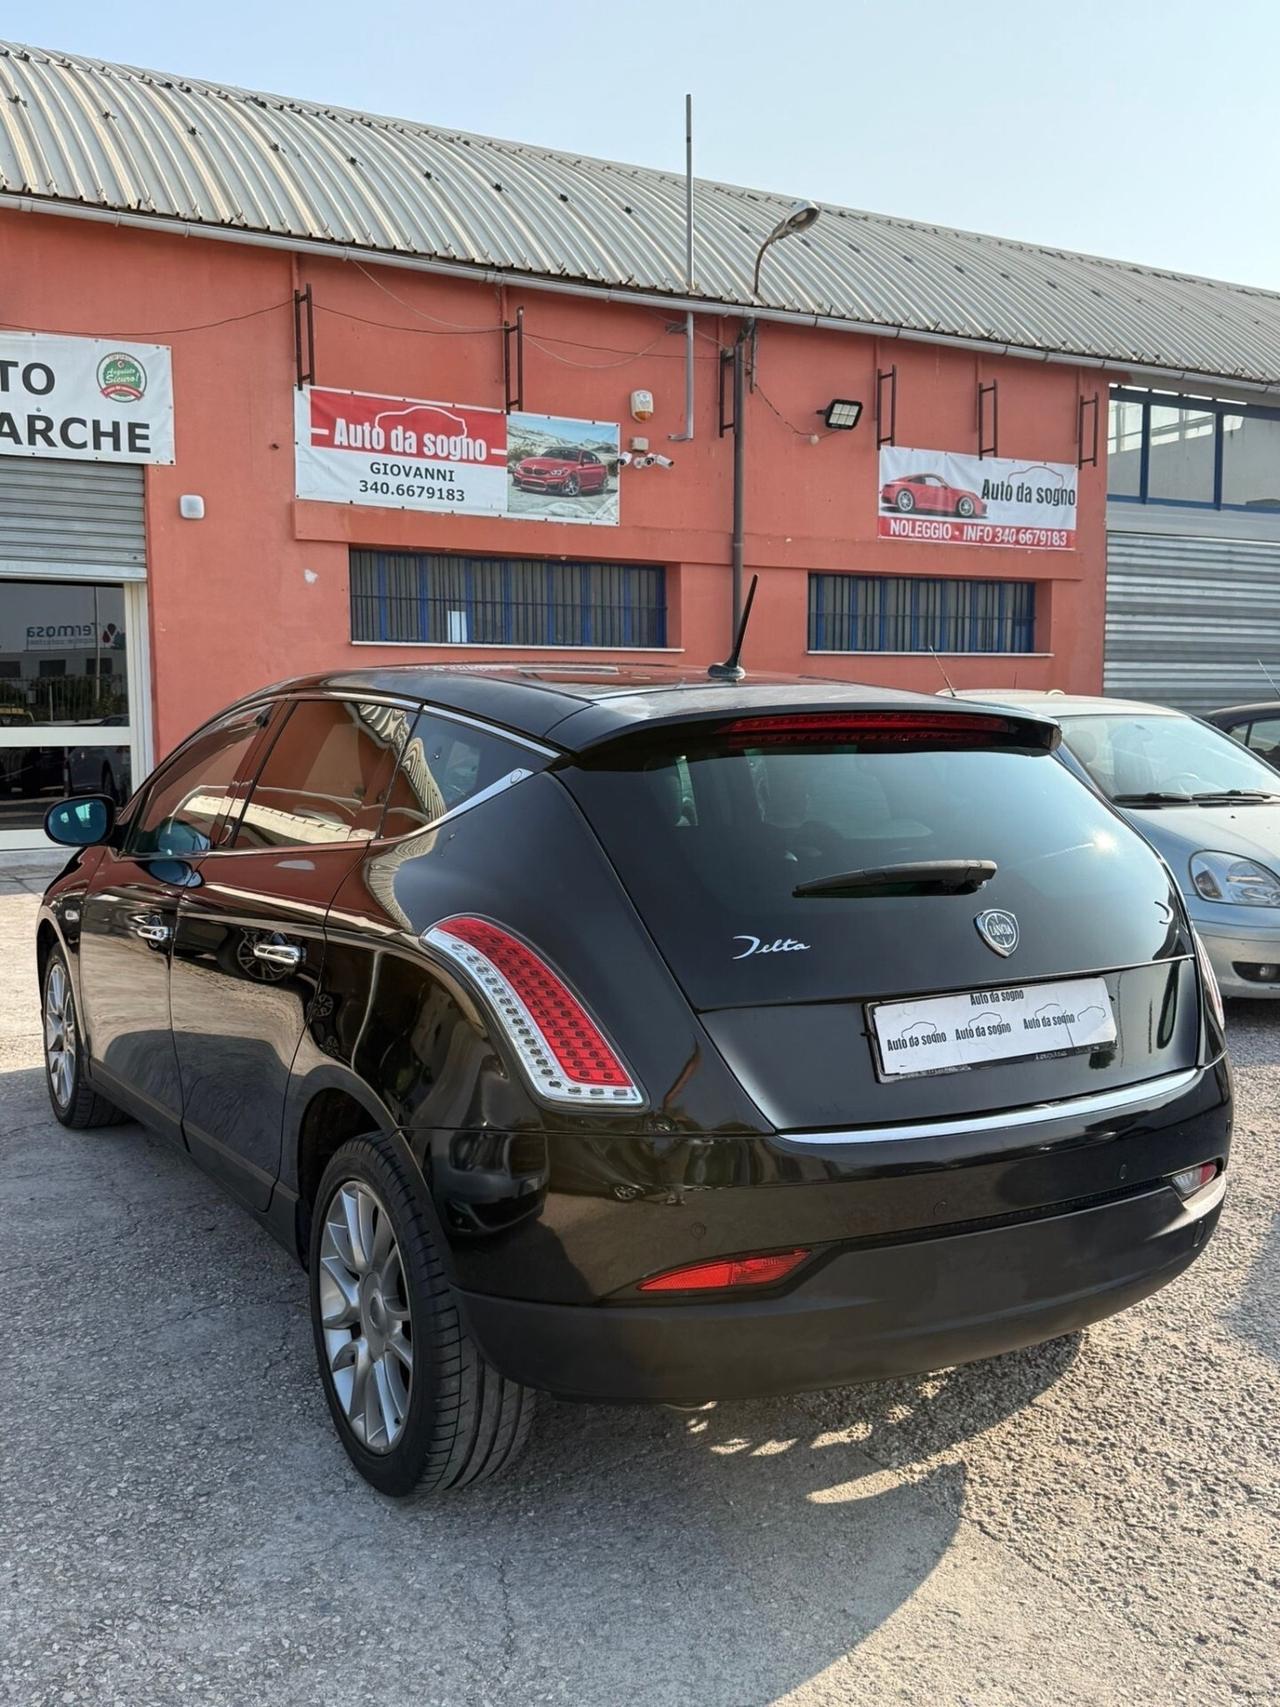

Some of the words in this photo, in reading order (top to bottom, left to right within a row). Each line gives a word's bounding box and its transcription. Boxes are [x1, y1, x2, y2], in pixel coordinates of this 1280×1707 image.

[0, 412, 151, 453] ARCHE
[334, 417, 385, 450] Auto
[391, 425, 417, 454] da
[423, 432, 487, 461] sogno
[370, 462, 455, 482] GIOVANNI
[359, 480, 465, 502] 340.6679183
[981, 478, 1013, 501] Auto
[1016, 482, 1033, 503] da
[1036, 486, 1076, 507] sogno
[890, 519, 951, 538] NOLEGGIO
[963, 526, 992, 542] INFO
[995, 528, 1016, 544] 340
[1018, 529, 1067, 546] 6679183
[732, 935, 811, 960] Delta
[970, 992, 989, 1006] Auto
[990, 990, 1000, 1003] da
[1001, 989, 1024, 1002] sogno
[955, 1027, 975, 1040] Auto
[976, 1024, 987, 1037] da
[988, 1022, 1012, 1035] sogno
[1023, 1017, 1041, 1030] Auto
[1041, 1014, 1052, 1027] da
[887, 1037, 907, 1051] Auto
[909, 1035, 920, 1048] da
